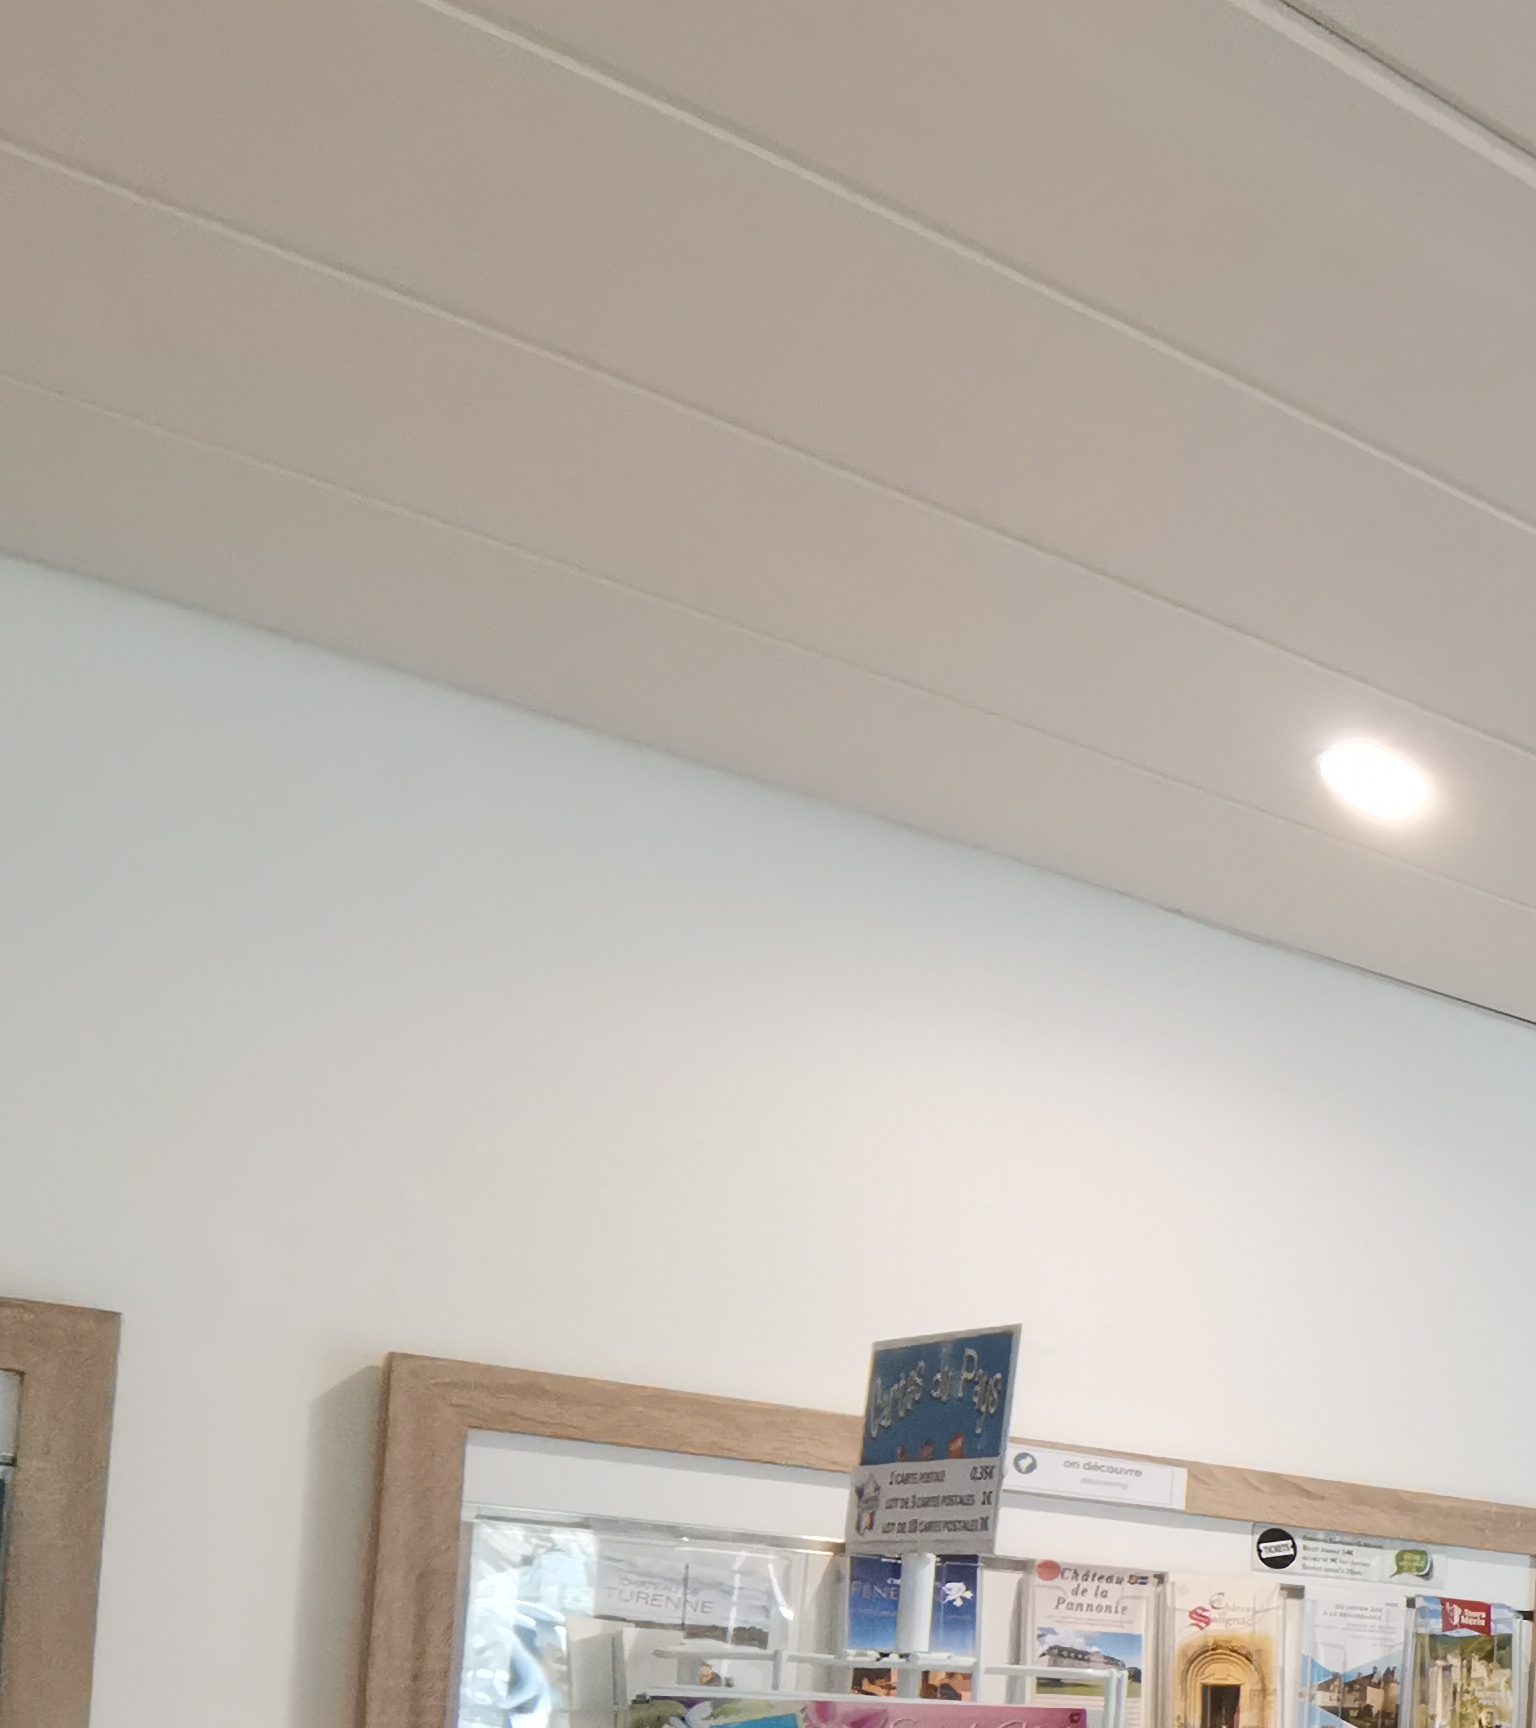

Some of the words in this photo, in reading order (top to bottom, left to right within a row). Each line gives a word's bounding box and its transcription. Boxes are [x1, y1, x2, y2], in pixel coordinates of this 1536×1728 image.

[1082, 1460, 1144, 1478] découvre
[1060, 1567, 1125, 1585] Château
[604, 1586, 714, 1614] TURENNE
[1071, 1583, 1086, 1598] de
[1094, 1585, 1109, 1599] la
[1054, 1596, 1129, 1616] Pannonie
